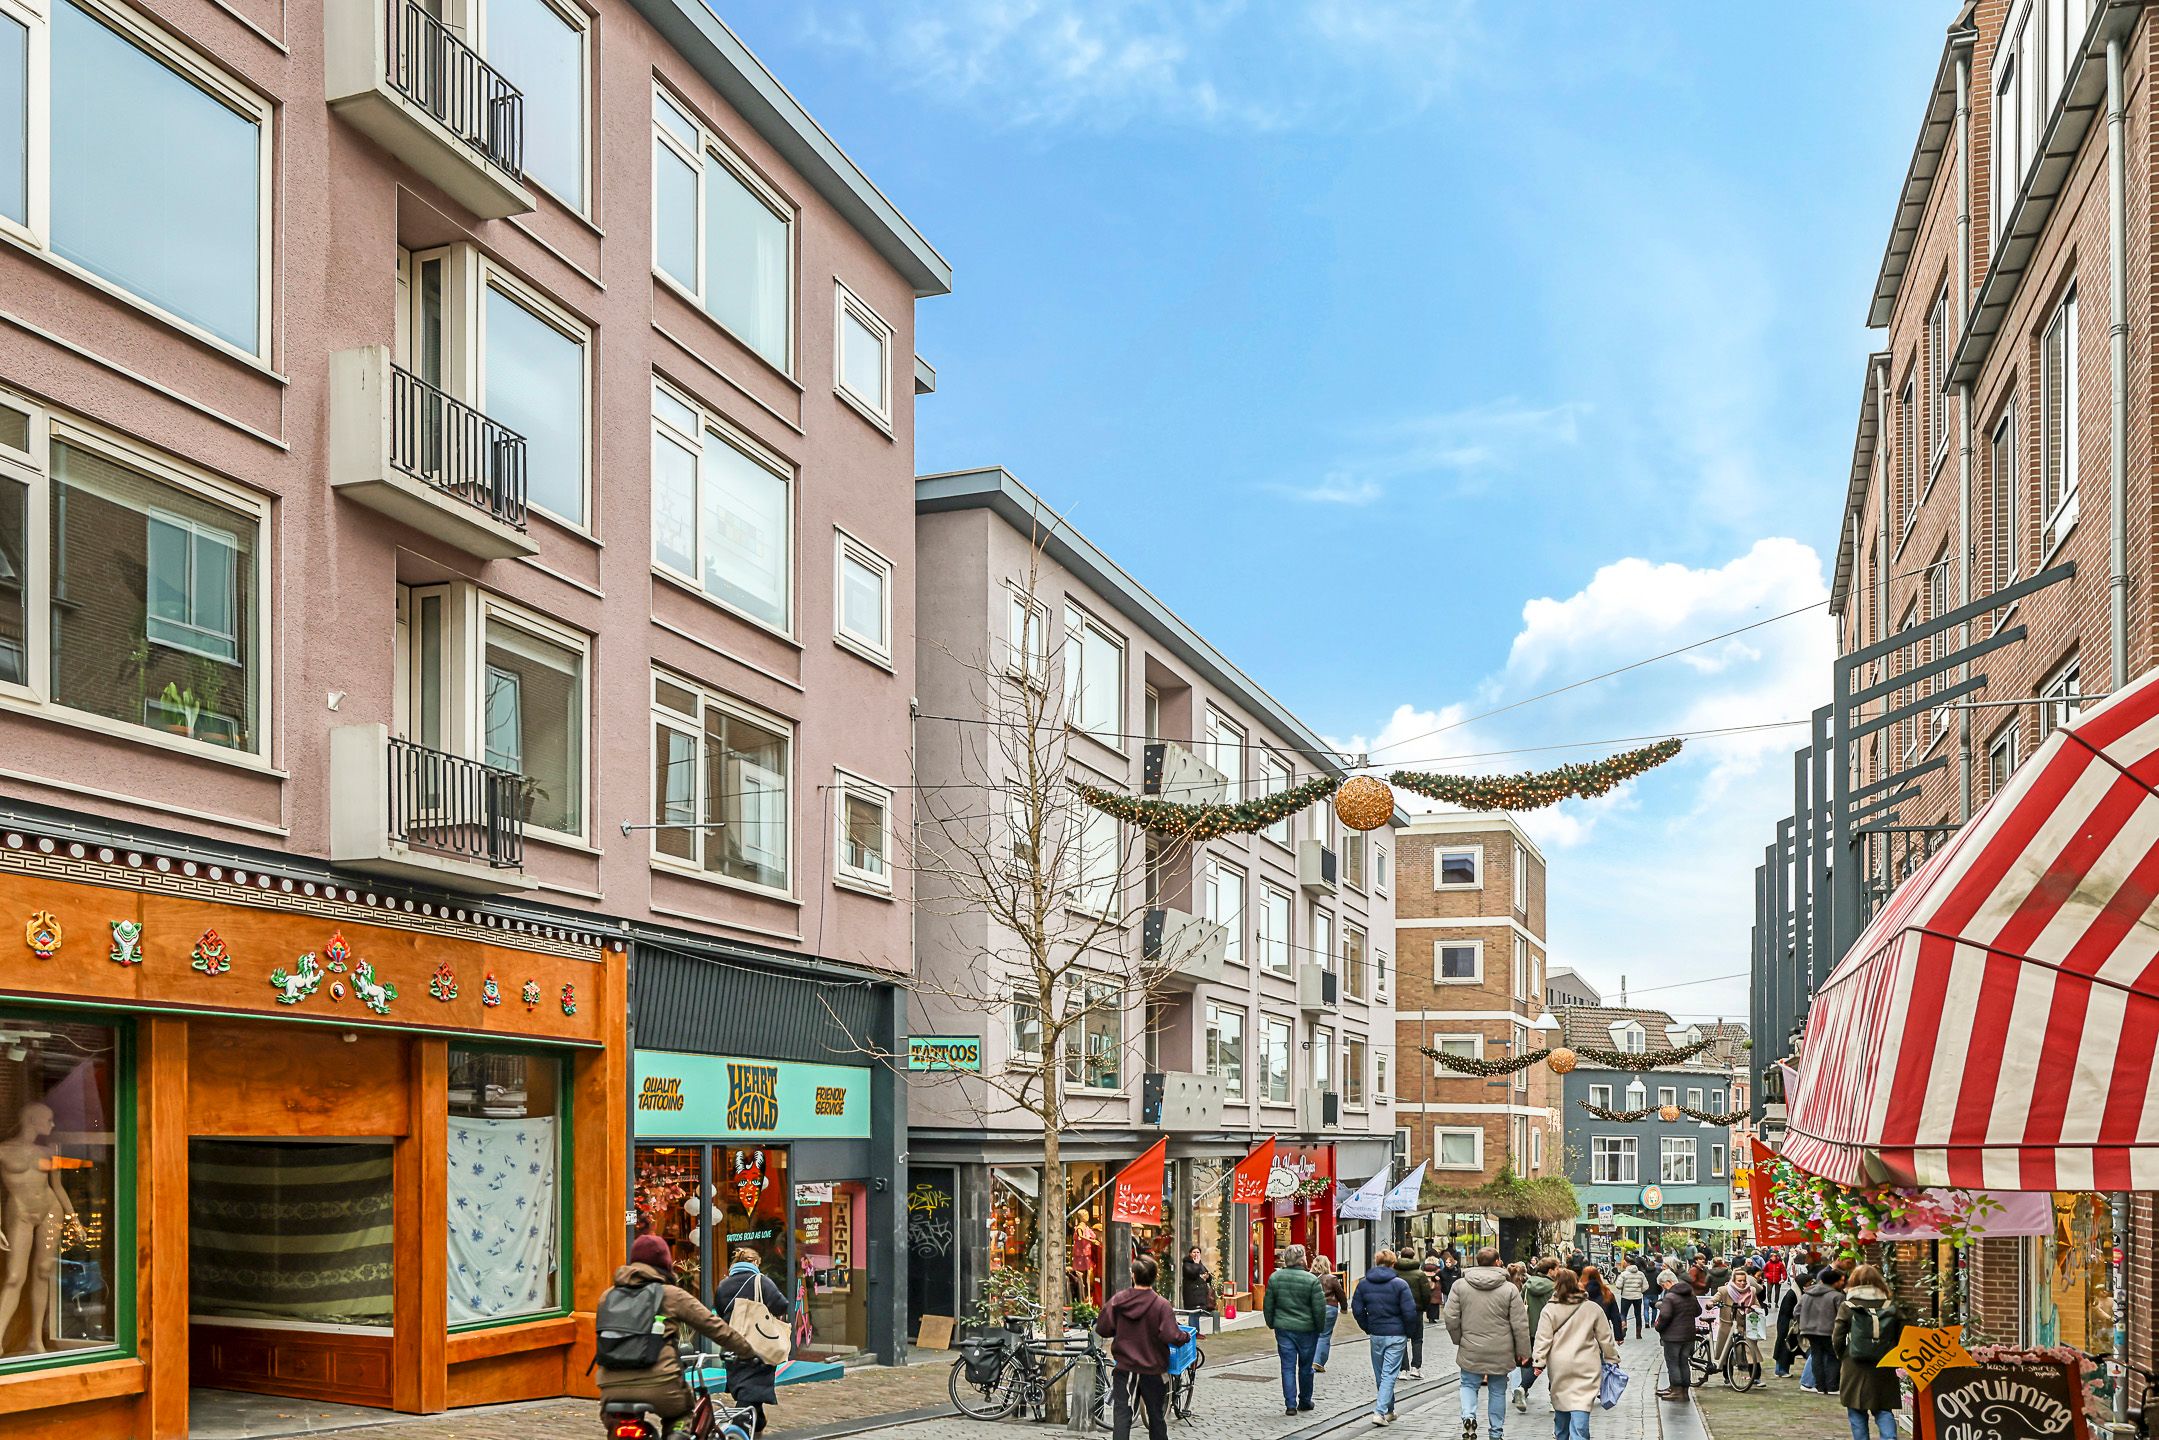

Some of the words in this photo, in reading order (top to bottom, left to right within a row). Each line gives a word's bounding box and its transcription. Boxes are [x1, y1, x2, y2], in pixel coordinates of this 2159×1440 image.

[911, 1044, 978, 1063] TATTOOS
[643, 1076, 681, 1093] QUALITY
[726, 1062, 778, 1109] HEART
[638, 1093, 684, 1111] TATTOOING
[815, 1086, 847, 1102] FRIENDLY
[727, 1108, 738, 1131] OF
[737, 1094, 779, 1131] GOLD
[814, 1100, 845, 1116] SERVICE
[1117, 1183, 1131, 1218] MAKE
[1130, 1192, 1151, 1204] MY
[1129, 1203, 1156, 1216] DAY
[834, 1202, 848, 1270] TATTO
[1900, 1328, 1955, 1373] Sale!
